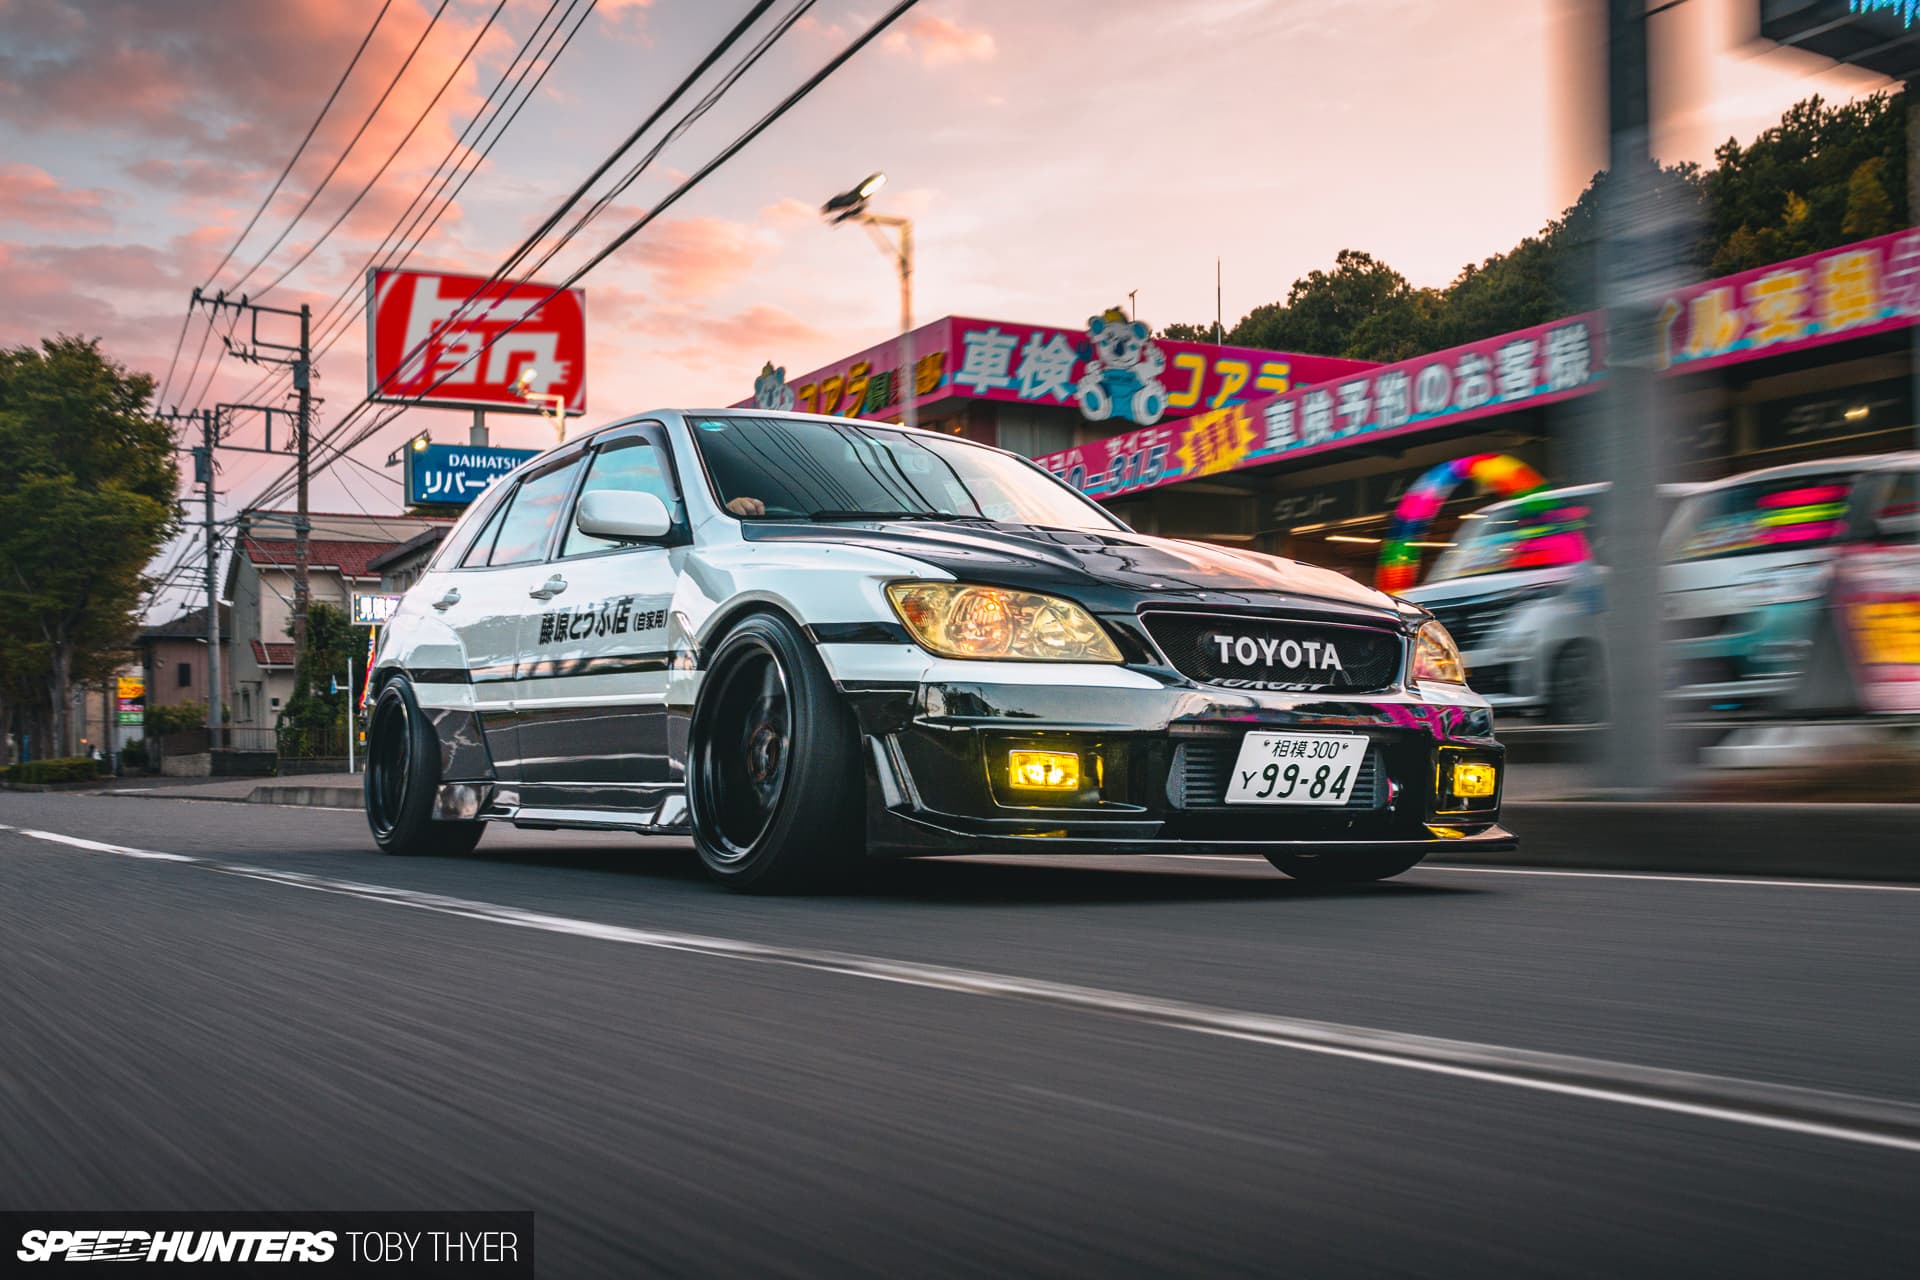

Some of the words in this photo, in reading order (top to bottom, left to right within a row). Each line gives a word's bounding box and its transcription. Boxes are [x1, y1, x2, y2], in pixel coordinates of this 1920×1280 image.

[954, 327, 1078, 403] 車検
[449, 454, 521, 470] DAIHATSU
[539, 596, 635, 645] 藤原とうふ店
[1214, 635, 1342, 671] TOYOTA
[1256, 763, 1352, 800] 99-84
